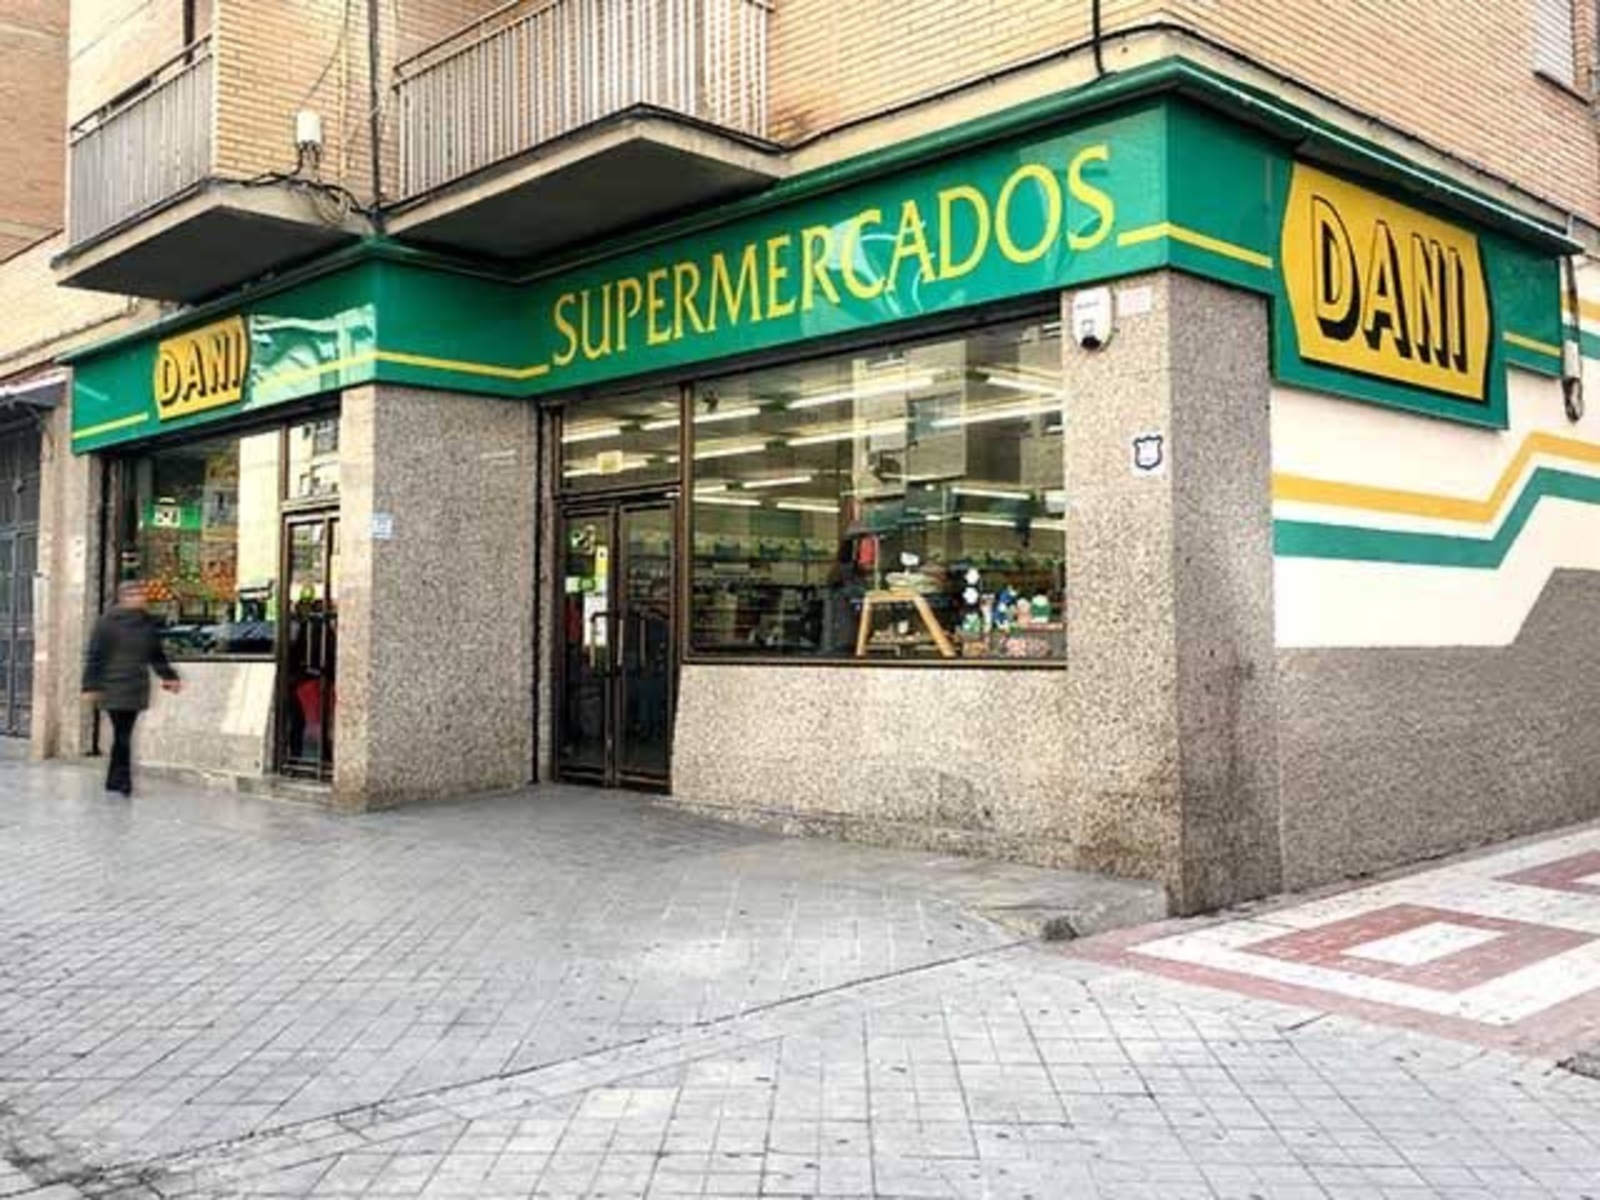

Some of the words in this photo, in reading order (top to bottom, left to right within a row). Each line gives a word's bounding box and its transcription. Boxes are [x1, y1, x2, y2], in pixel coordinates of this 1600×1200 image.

[551, 144, 1115, 367] SUPERMERCADOS
[1311, 194, 1468, 375] DANI
[160, 329, 242, 408] DANI
